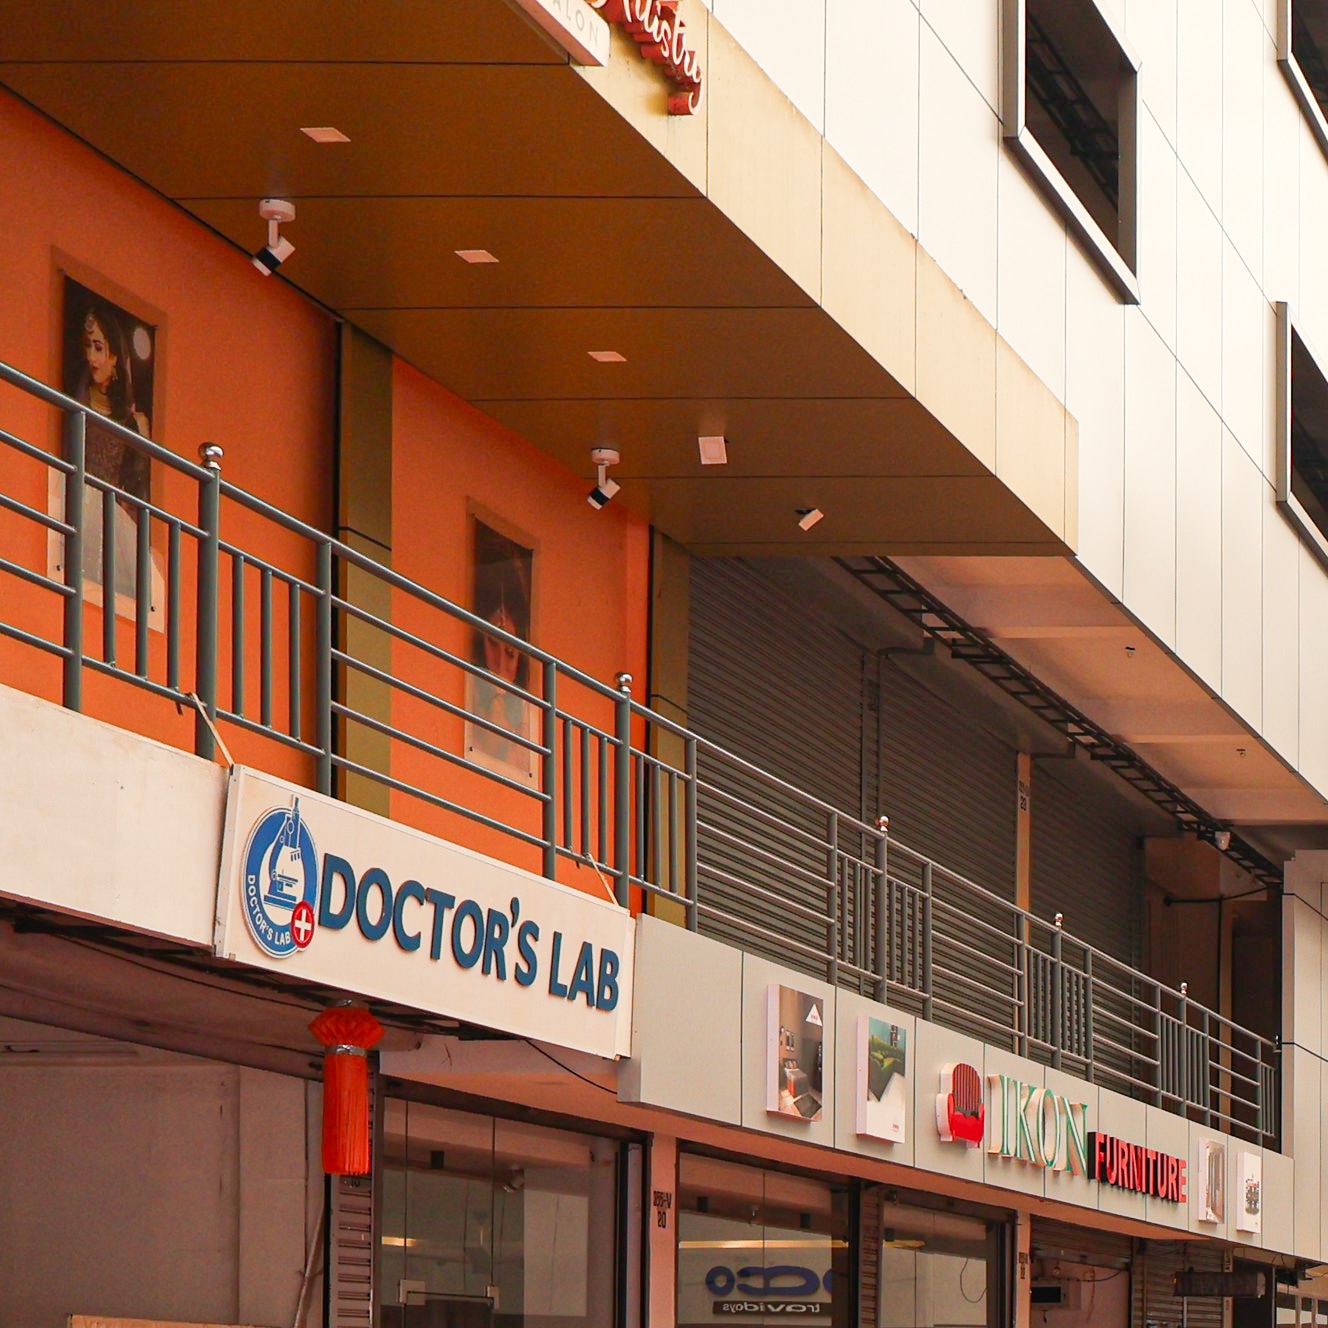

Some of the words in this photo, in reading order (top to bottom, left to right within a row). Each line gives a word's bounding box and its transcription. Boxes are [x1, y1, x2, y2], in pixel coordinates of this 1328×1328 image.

[551, 0, 599, 46] ALON
[248, 875, 274, 941] DOCTOR'S
[275, 931, 291, 945] LAB
[318, 852, 540, 988] DOCTOR'S
[549, 930, 621, 1013] LAB
[990, 1074, 1088, 1177] IKON
[1088, 1132, 1187, 1204] FURNITURE
